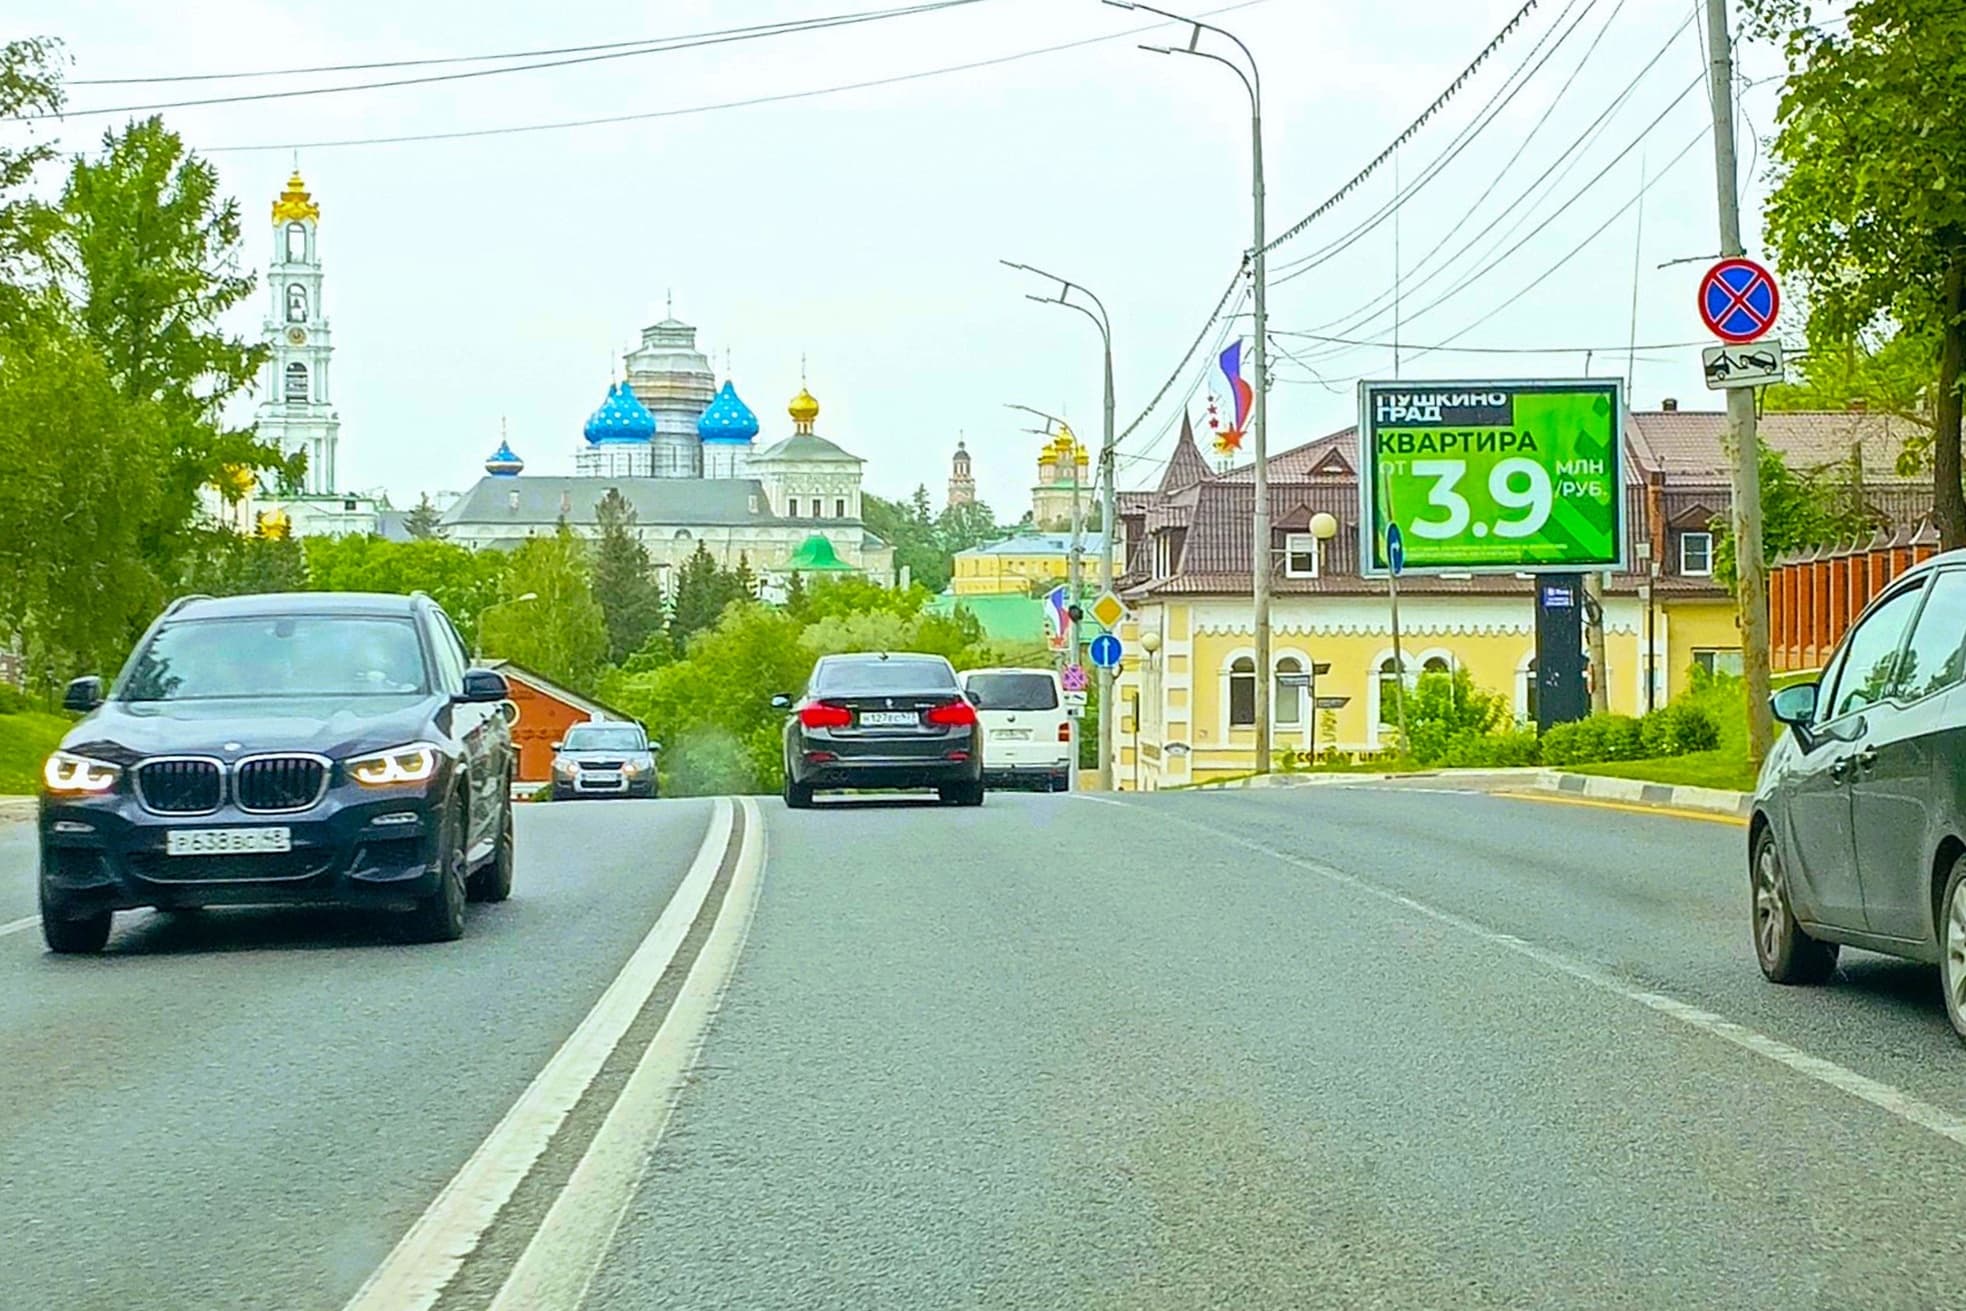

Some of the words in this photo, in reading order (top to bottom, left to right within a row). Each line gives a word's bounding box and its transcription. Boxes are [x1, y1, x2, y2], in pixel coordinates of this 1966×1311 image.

[1376, 392, 1507, 408] ПУШКИНО
[1376, 406, 1443, 423] ГРАД
[1377, 431, 1538, 454] КВАРТИРА
[1378, 460, 1407, 476] ОТ
[1409, 456, 1553, 540] 3.9
[1555, 459, 1604, 475] МЛН
